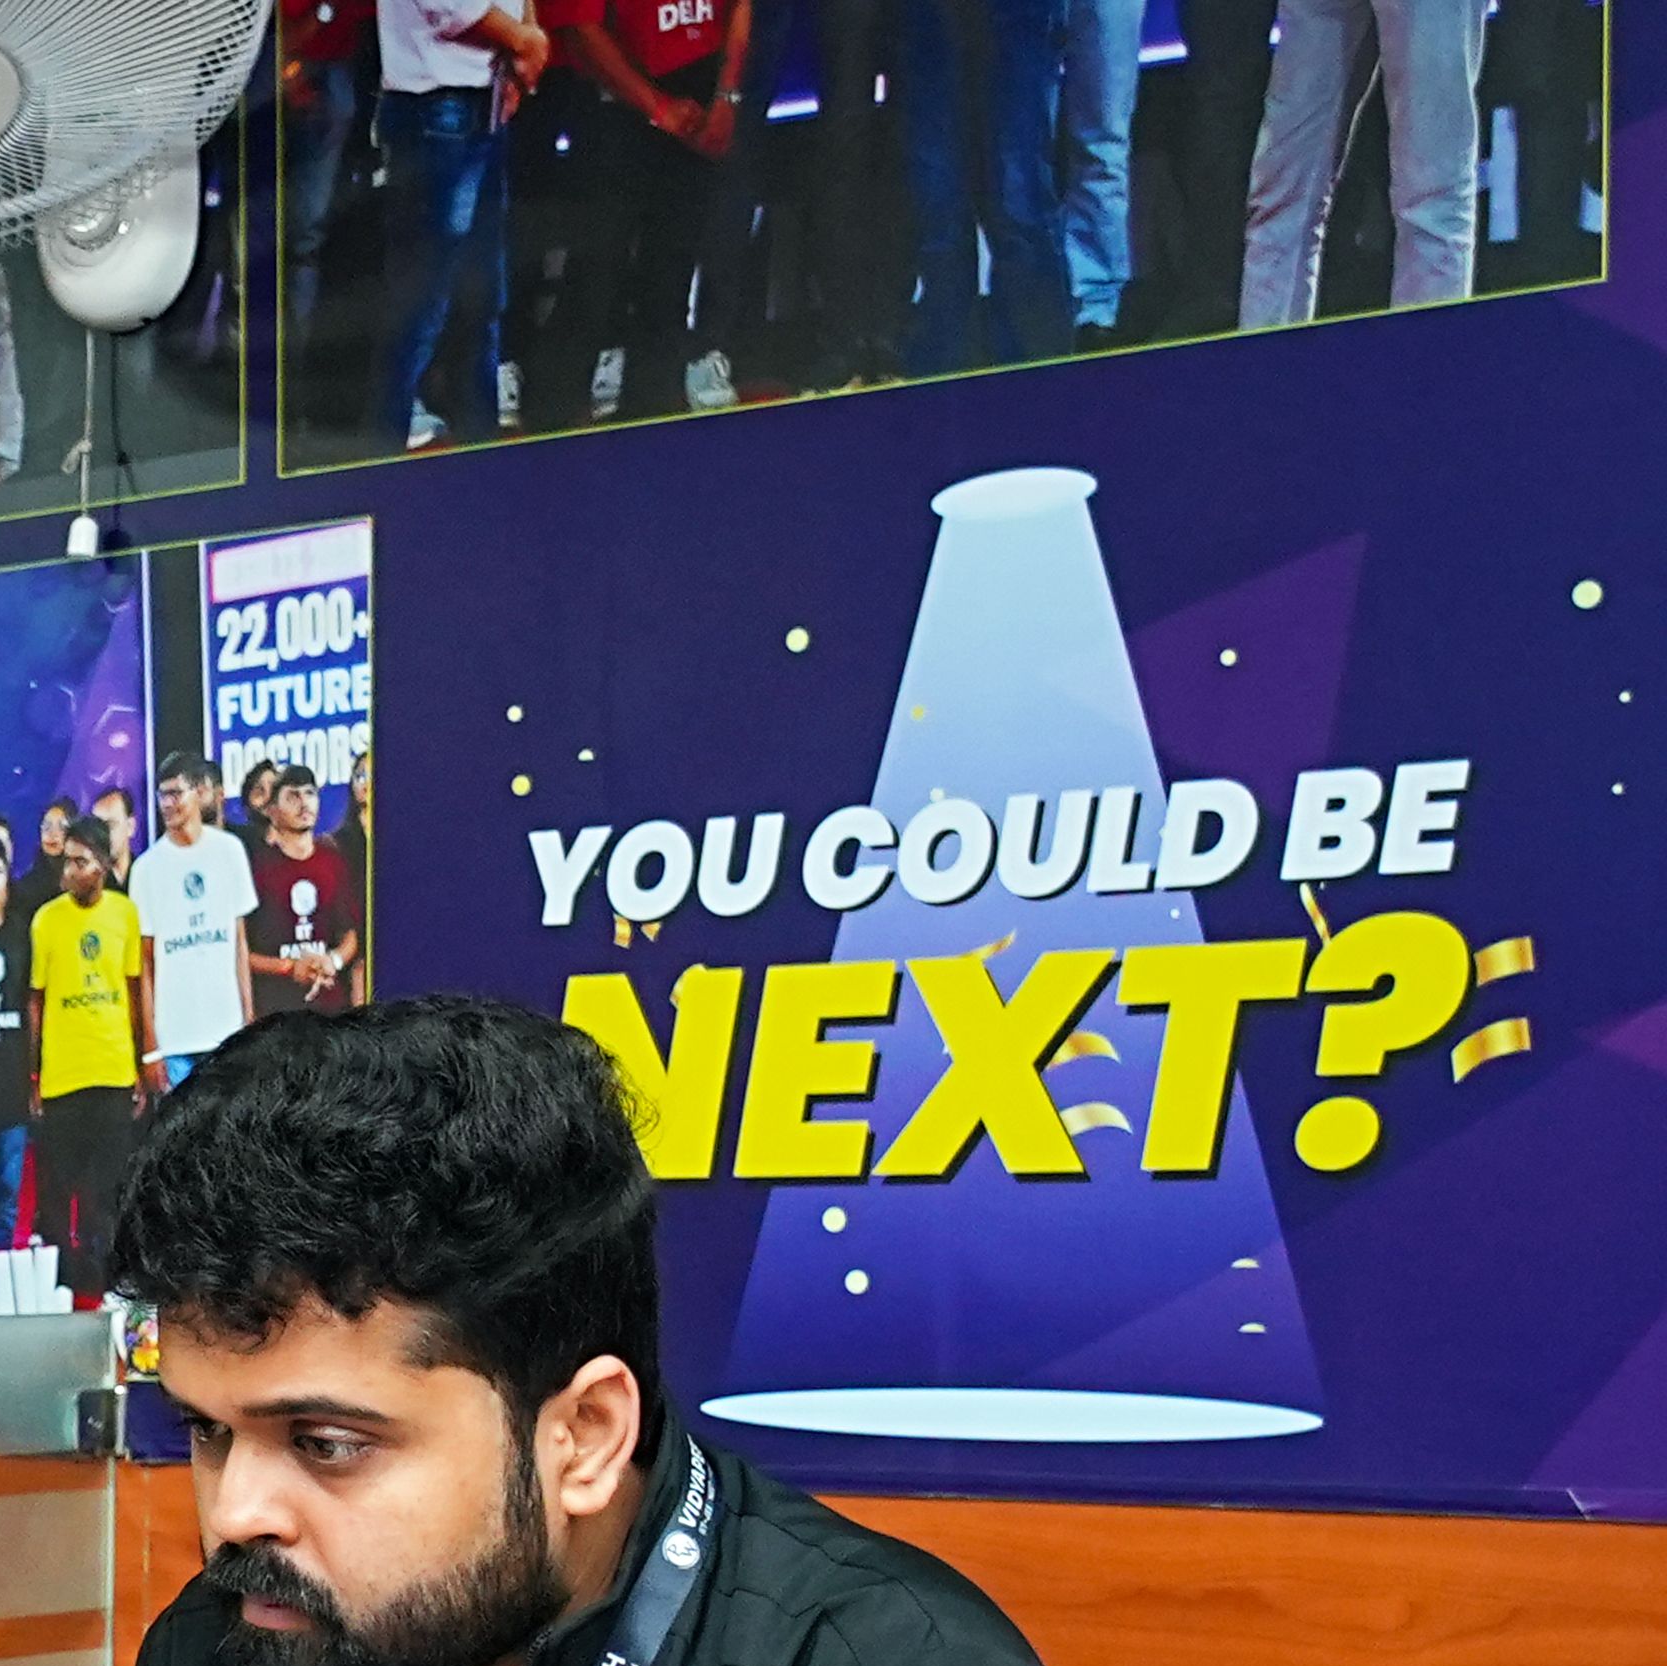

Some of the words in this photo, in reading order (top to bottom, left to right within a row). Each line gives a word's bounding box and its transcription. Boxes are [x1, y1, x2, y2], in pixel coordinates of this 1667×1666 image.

[217, 588, 369, 674] 22,000+
[218, 663, 370, 731] FUTURE
[528, 812, 784, 927] YOU
[802, 778, 1259, 911] COULD
[1279, 759, 1470, 883] BE
[558, 911, 1470, 1186] NEXT?
